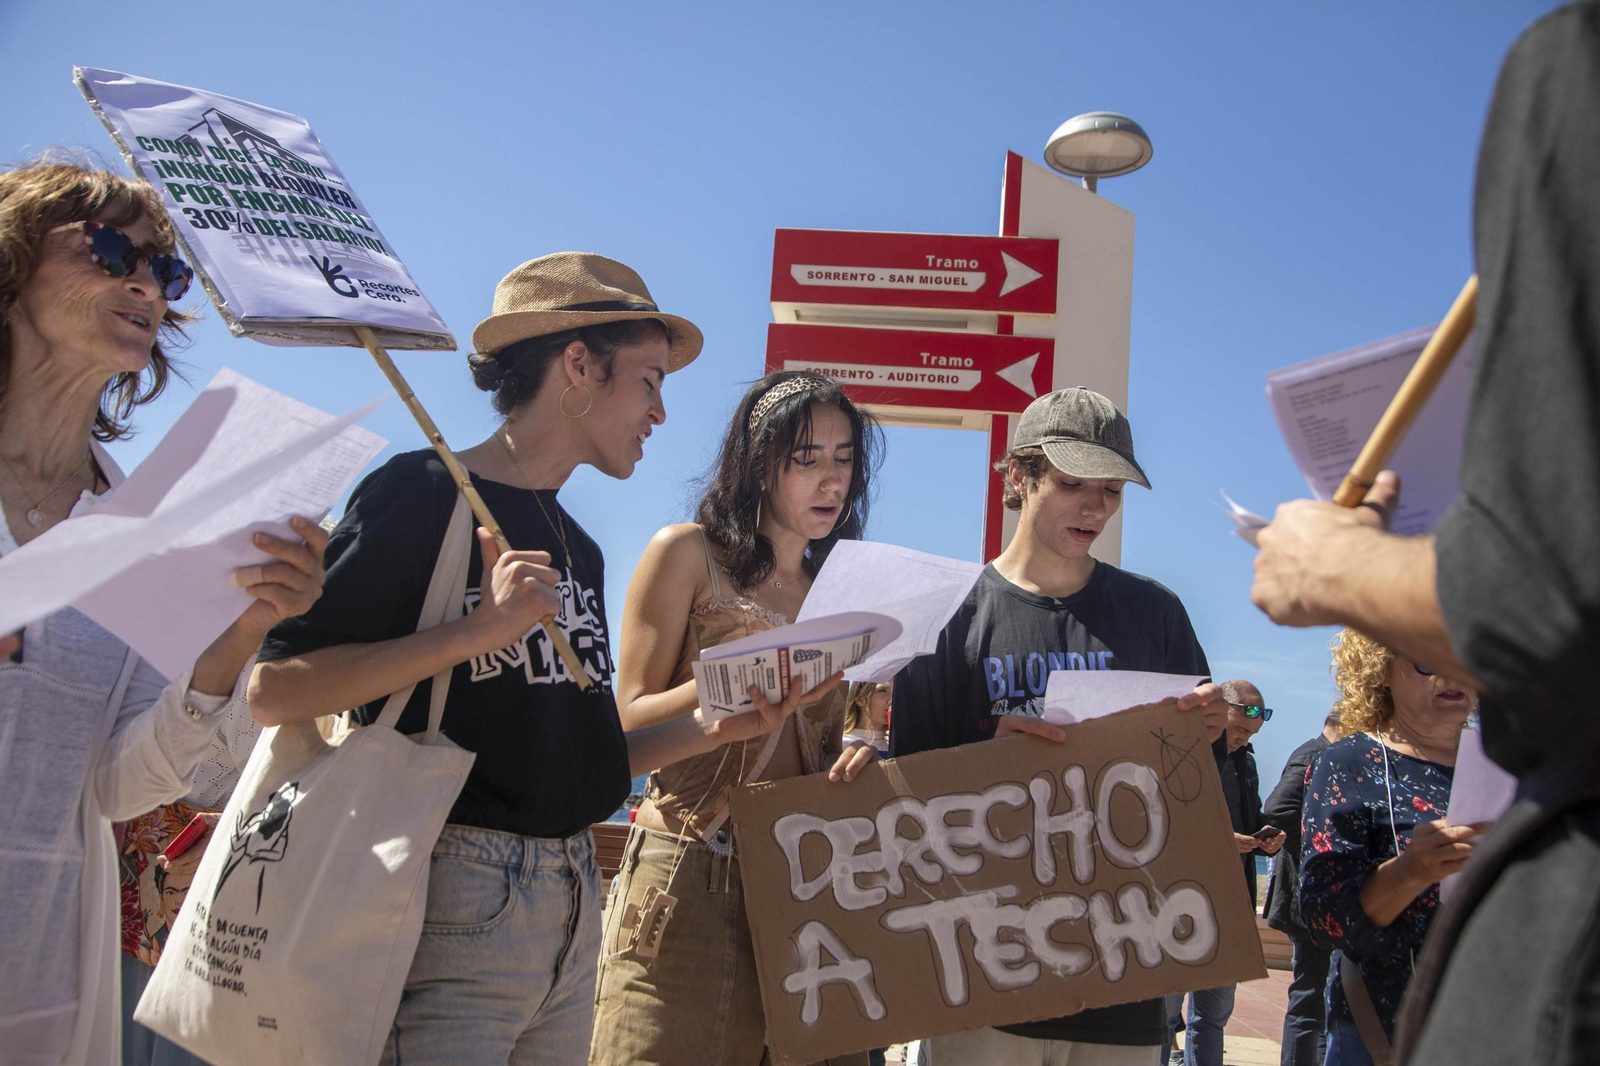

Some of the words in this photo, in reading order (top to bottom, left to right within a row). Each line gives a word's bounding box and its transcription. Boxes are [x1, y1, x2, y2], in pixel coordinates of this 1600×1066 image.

[136, 136, 202, 157] COMO
[206, 145, 257, 164] DICE
[260, 152, 287, 170] LA
[151, 159, 261, 187] ¡NINGÚN
[259, 171, 357, 209] ALQUILER
[165, 182, 231, 207] POR
[228, 189, 333, 219] ENCIMA
[328, 205, 374, 232] DEL
[182, 207, 256, 235] 30%
[251, 217, 299, 239] DEL
[294, 221, 389, 256] SALARIO!
[926, 254, 979, 269] Tramo
[356, 279, 420, 297] Recortes
[807, 270, 876, 282] SORRENTO
[888, 274, 915, 284] SAN
[919, 275, 968, 286] MIGUEL
[920, 352, 974, 367] Tramo
[887, 372, 960, 384] AUDITORIO
[774, 760, 1170, 911] DERECHO
[228, 922, 268, 944] CUENTA
[209, 936, 241, 956] ALGÚN
[243, 941, 262, 962] DÍA
[781, 918, 888, 1024] A
[880, 879, 1219, 1008] TECHO
